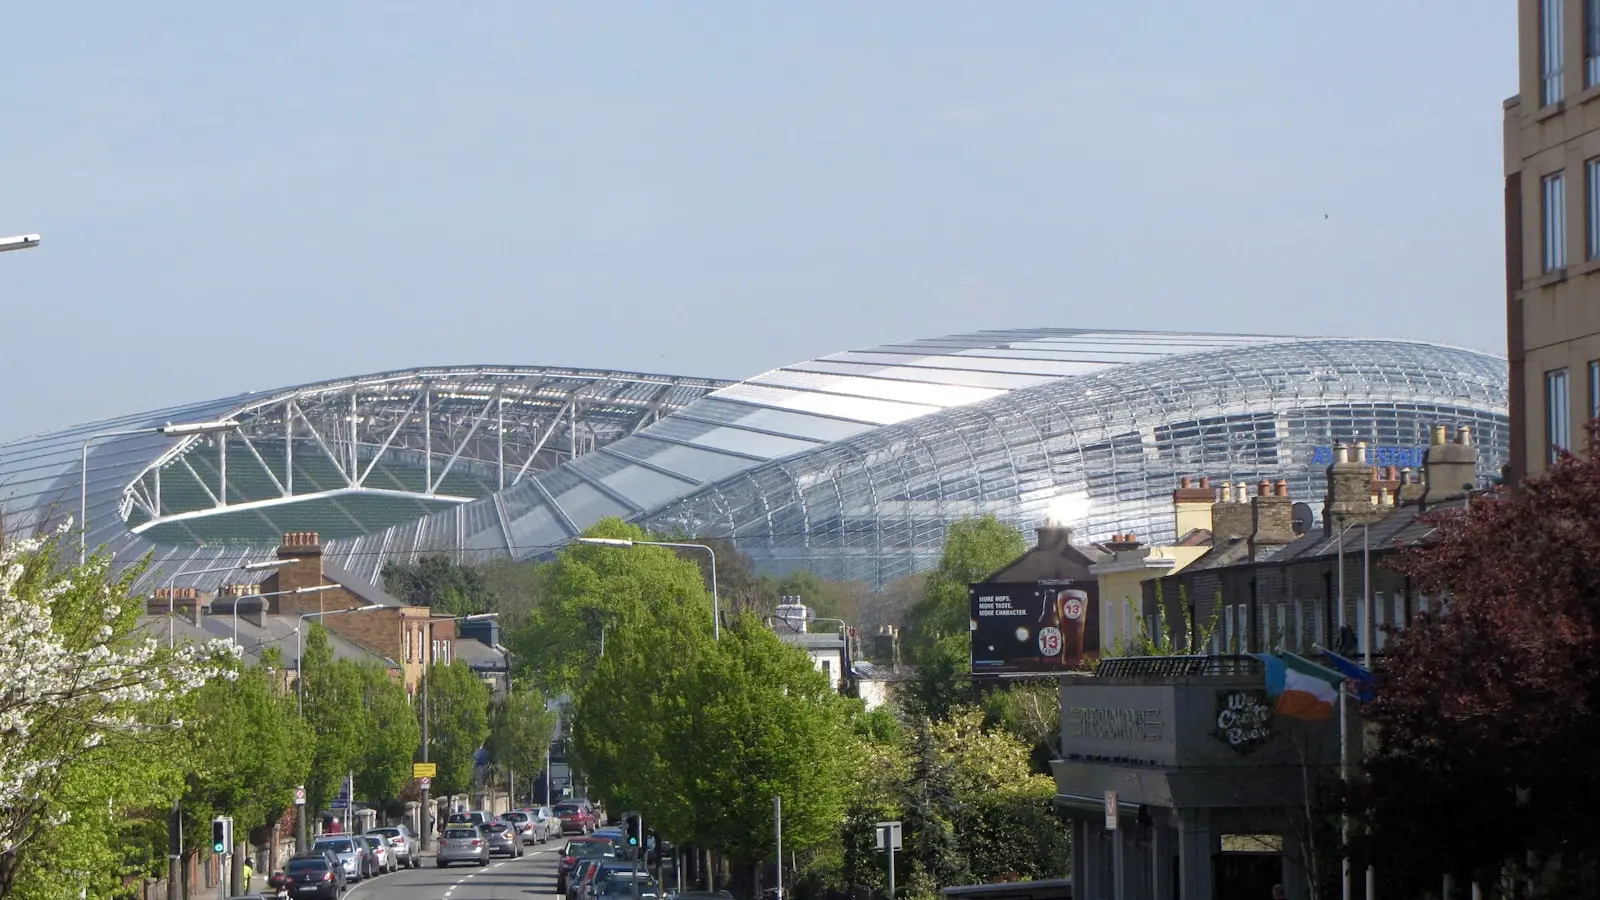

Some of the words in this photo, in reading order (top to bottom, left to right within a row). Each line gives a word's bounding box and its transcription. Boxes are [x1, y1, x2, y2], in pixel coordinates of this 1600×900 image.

[1376, 446, 1424, 467] STAD
[1066, 604, 1080, 614] 13
[1041, 635, 1058, 649] 13
[1228, 693, 1257, 710] We
[1226, 727, 1270, 745] Beer
